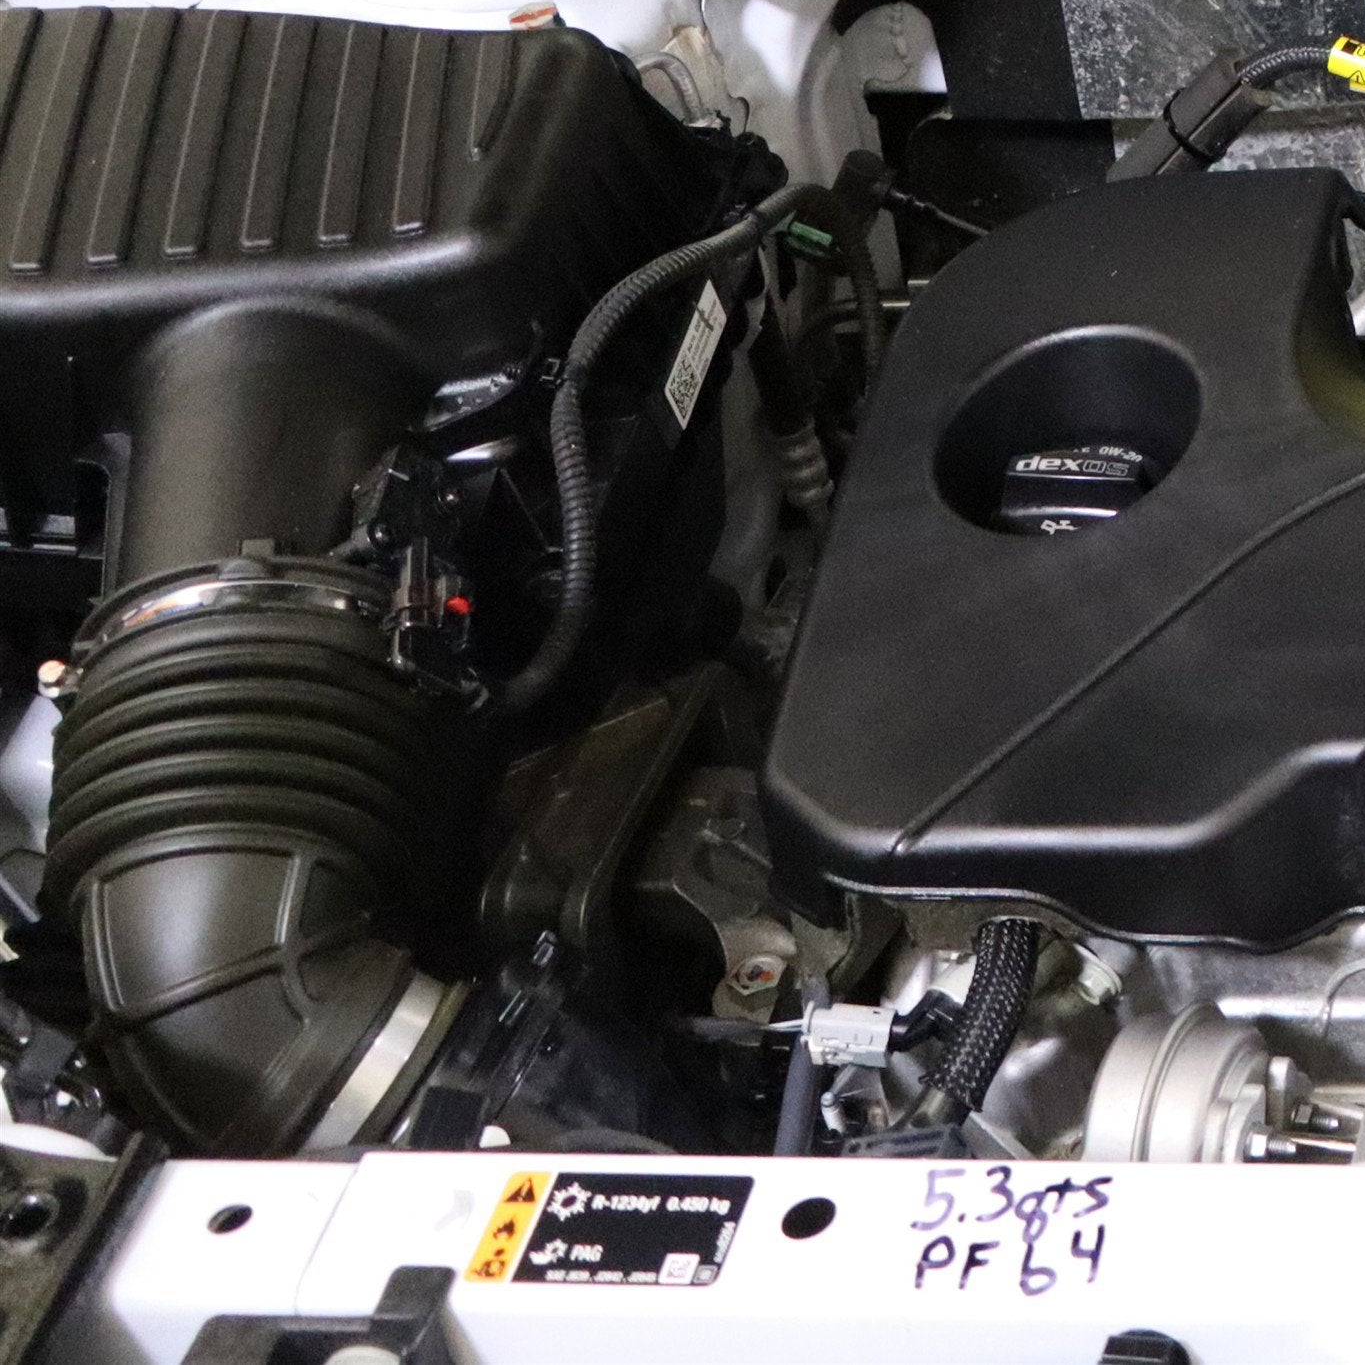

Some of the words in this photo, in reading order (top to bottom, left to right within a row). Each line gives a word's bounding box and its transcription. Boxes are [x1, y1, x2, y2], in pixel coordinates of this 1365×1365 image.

[1015, 455, 1131, 477] dexos
[591, 1194, 661, 1214] R-1234yf
[710, 1199, 732, 1216] kg
[570, 1244, 604, 1262] PAG
